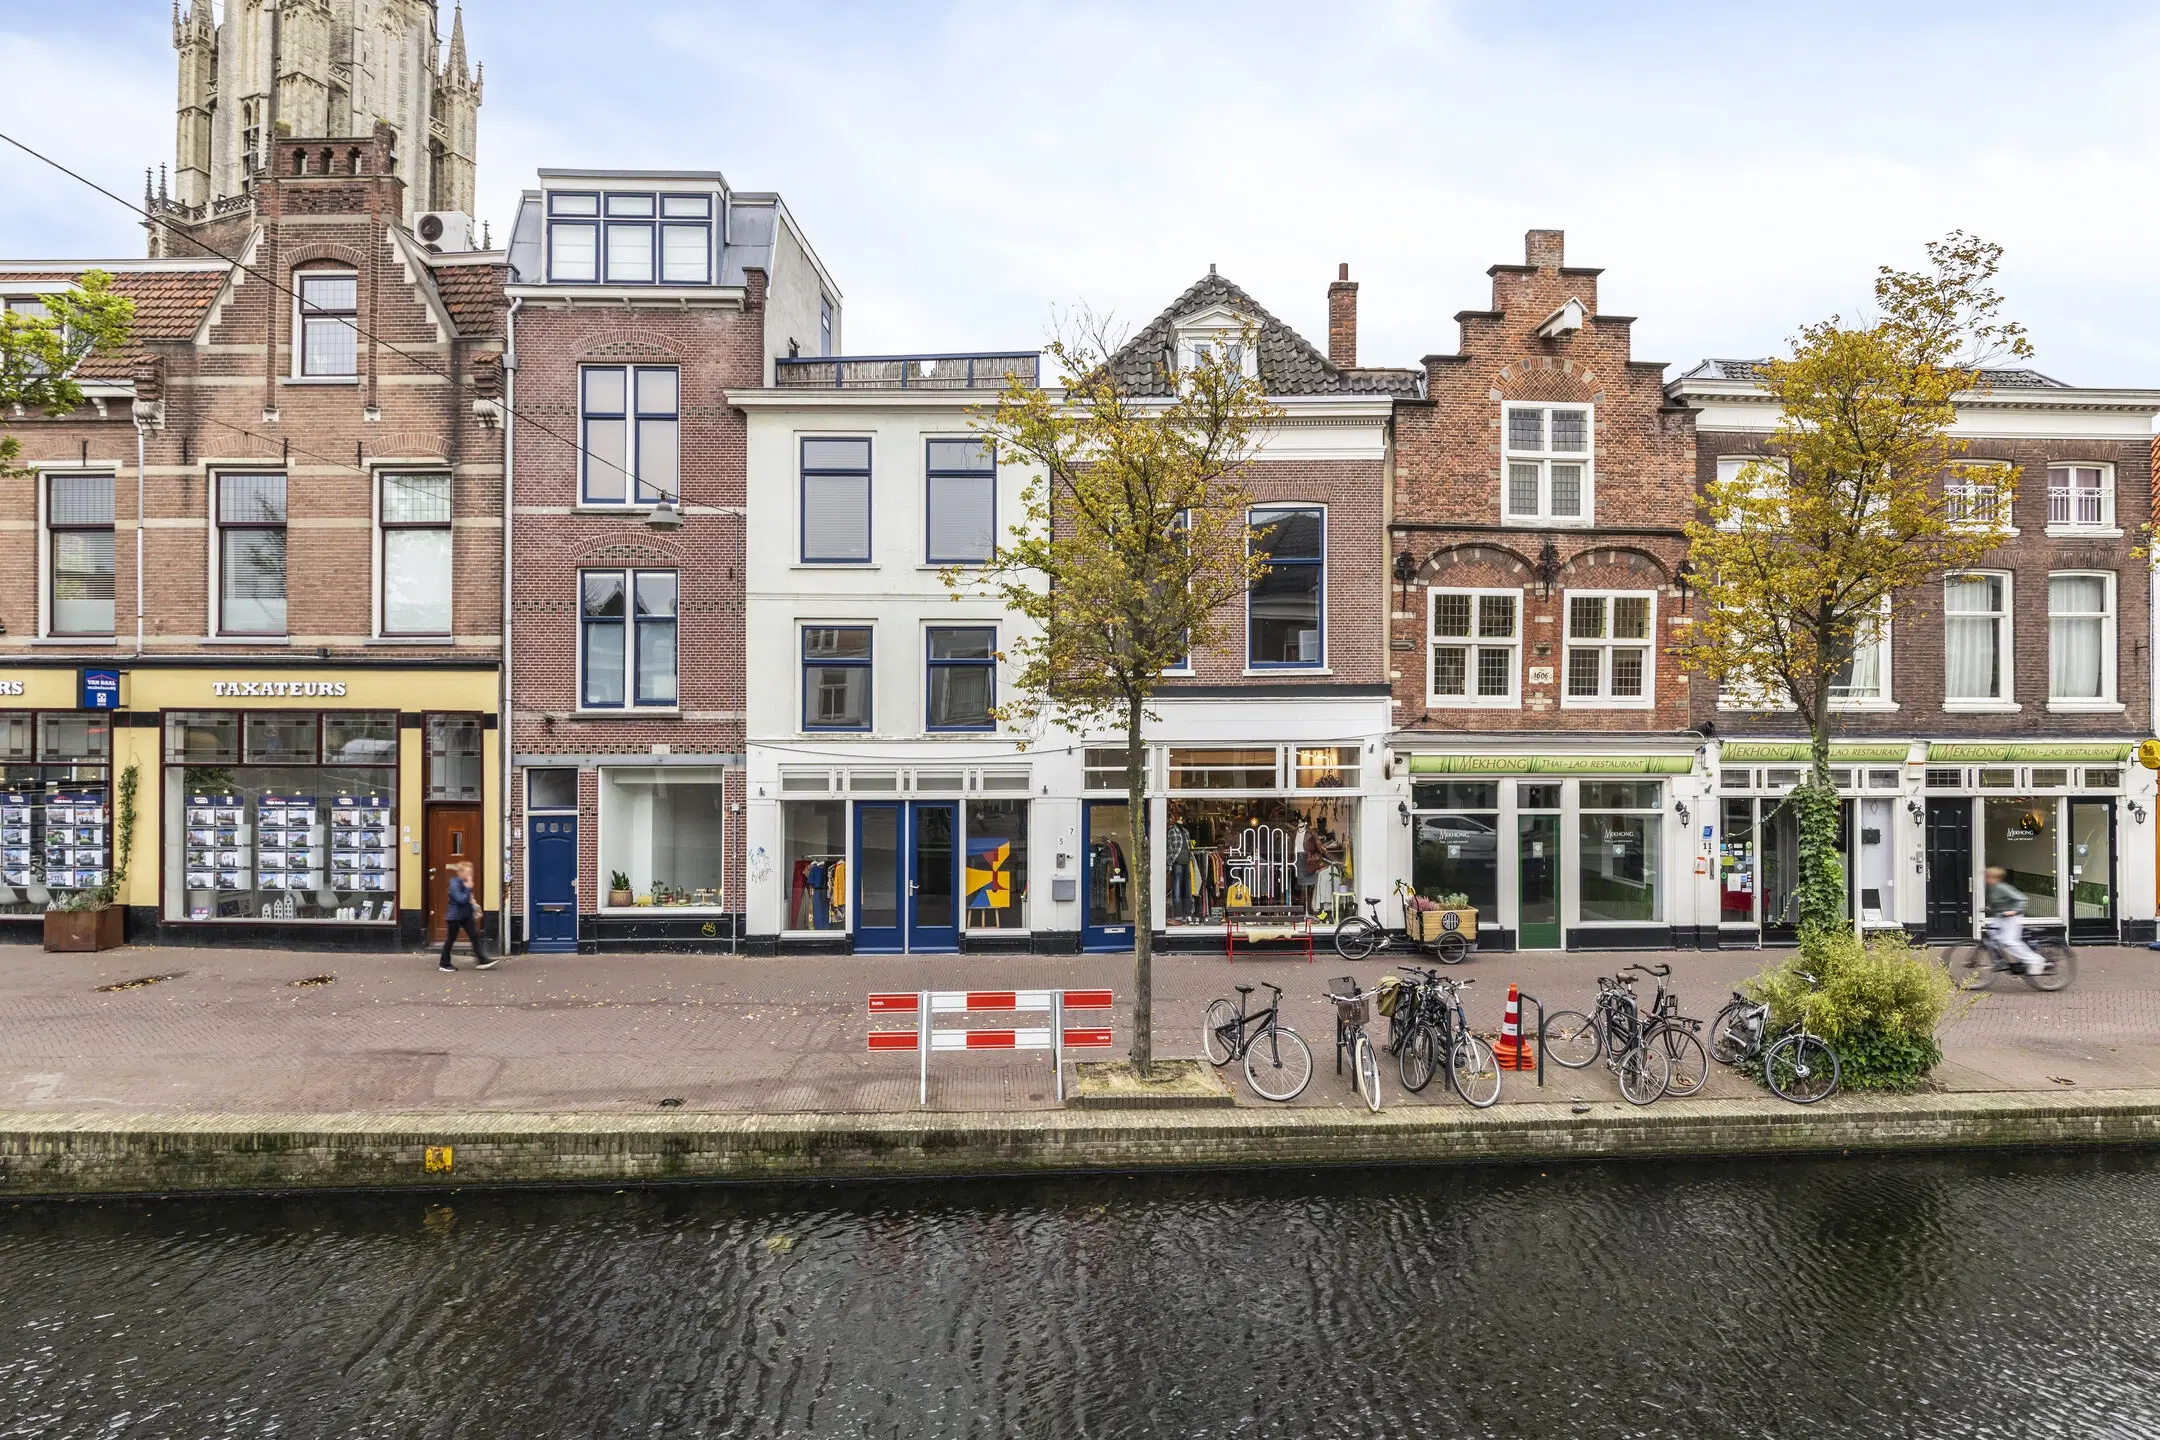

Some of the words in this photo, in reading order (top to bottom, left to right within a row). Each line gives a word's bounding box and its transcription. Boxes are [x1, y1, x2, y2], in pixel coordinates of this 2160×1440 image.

[212, 682, 346, 696] TAXATEURS
[1723, 744, 1790, 760] MEKHONG
[1851, 748, 1905, 756] RESTAURANT
[1941, 744, 2005, 758] MEKHONG
[2064, 748, 2117, 756] RESTAURANT
[1461, 756, 1526, 771] MEKHONG
[1590, 760, 1644, 768] RESTAURANT
[1703, 842, 1712, 850] 11
